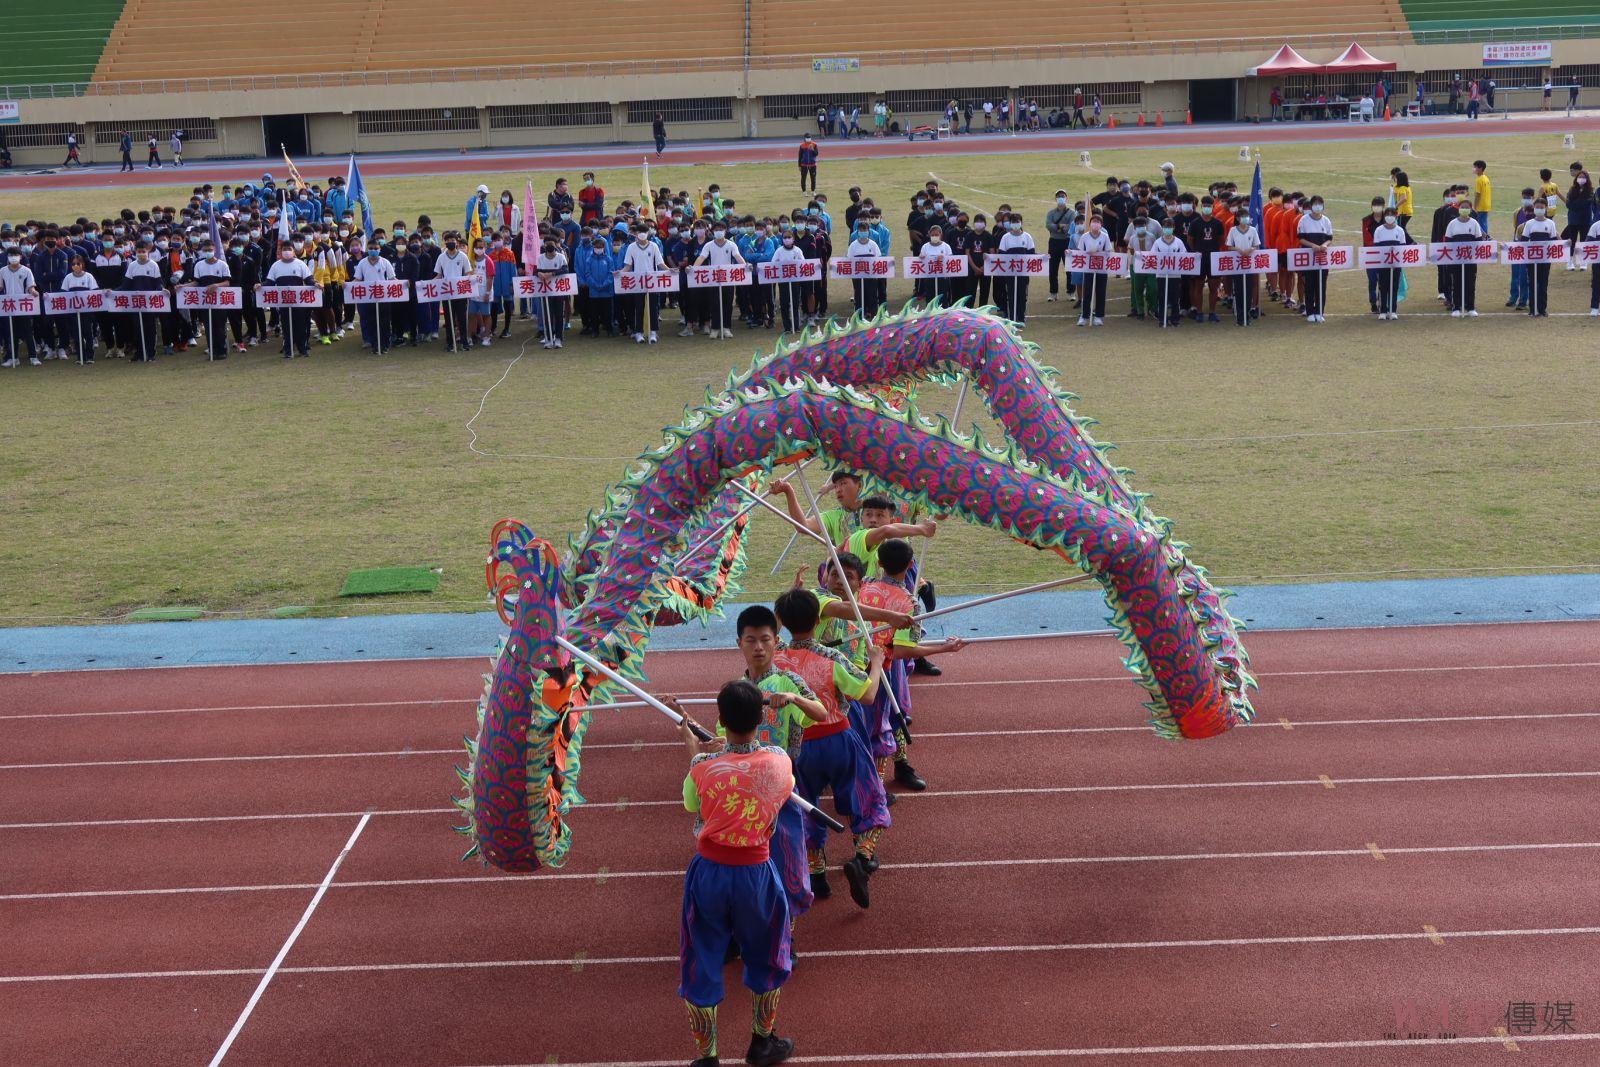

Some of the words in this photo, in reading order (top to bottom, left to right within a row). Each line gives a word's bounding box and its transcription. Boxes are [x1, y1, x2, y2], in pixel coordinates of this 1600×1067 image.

[1293, 250, 1347, 267] 田尾鄉
[1365, 248, 1419, 265] 二水鄉
[1436, 245, 1492, 261] 大城鄉
[1507, 244, 1564, 261] 線西鄉
[1582, 244, 1600, 260] 芳
[836, 260, 889, 275] 福興鄉
[910, 258, 962, 275] 永靖鄉
[991, 258, 1043, 273] 大村鄉
[1071, 255, 1121, 271] 芬園鄉
[1141, 254, 1195, 271] 溪州鄉
[1218, 253, 1271, 271] 鹿港鎮
[694, 267, 746, 285] 花壇鄉
[763, 262, 816, 280] 社頭鄉
[422, 279, 473, 298] 北斗鎮
[519, 277, 571, 295] 秀水鄉
[620, 274, 673, 291] 彰化市
[262, 289, 316, 304] 埔鹽鄉
[350, 284, 403, 300] 伸港鄉
[2, 298, 34, 313] 林市
[51, 293, 103, 310] 埔心鄉
[113, 294, 165, 309] 埤頭鄉
[722, 791, 760, 821] 芳苑
